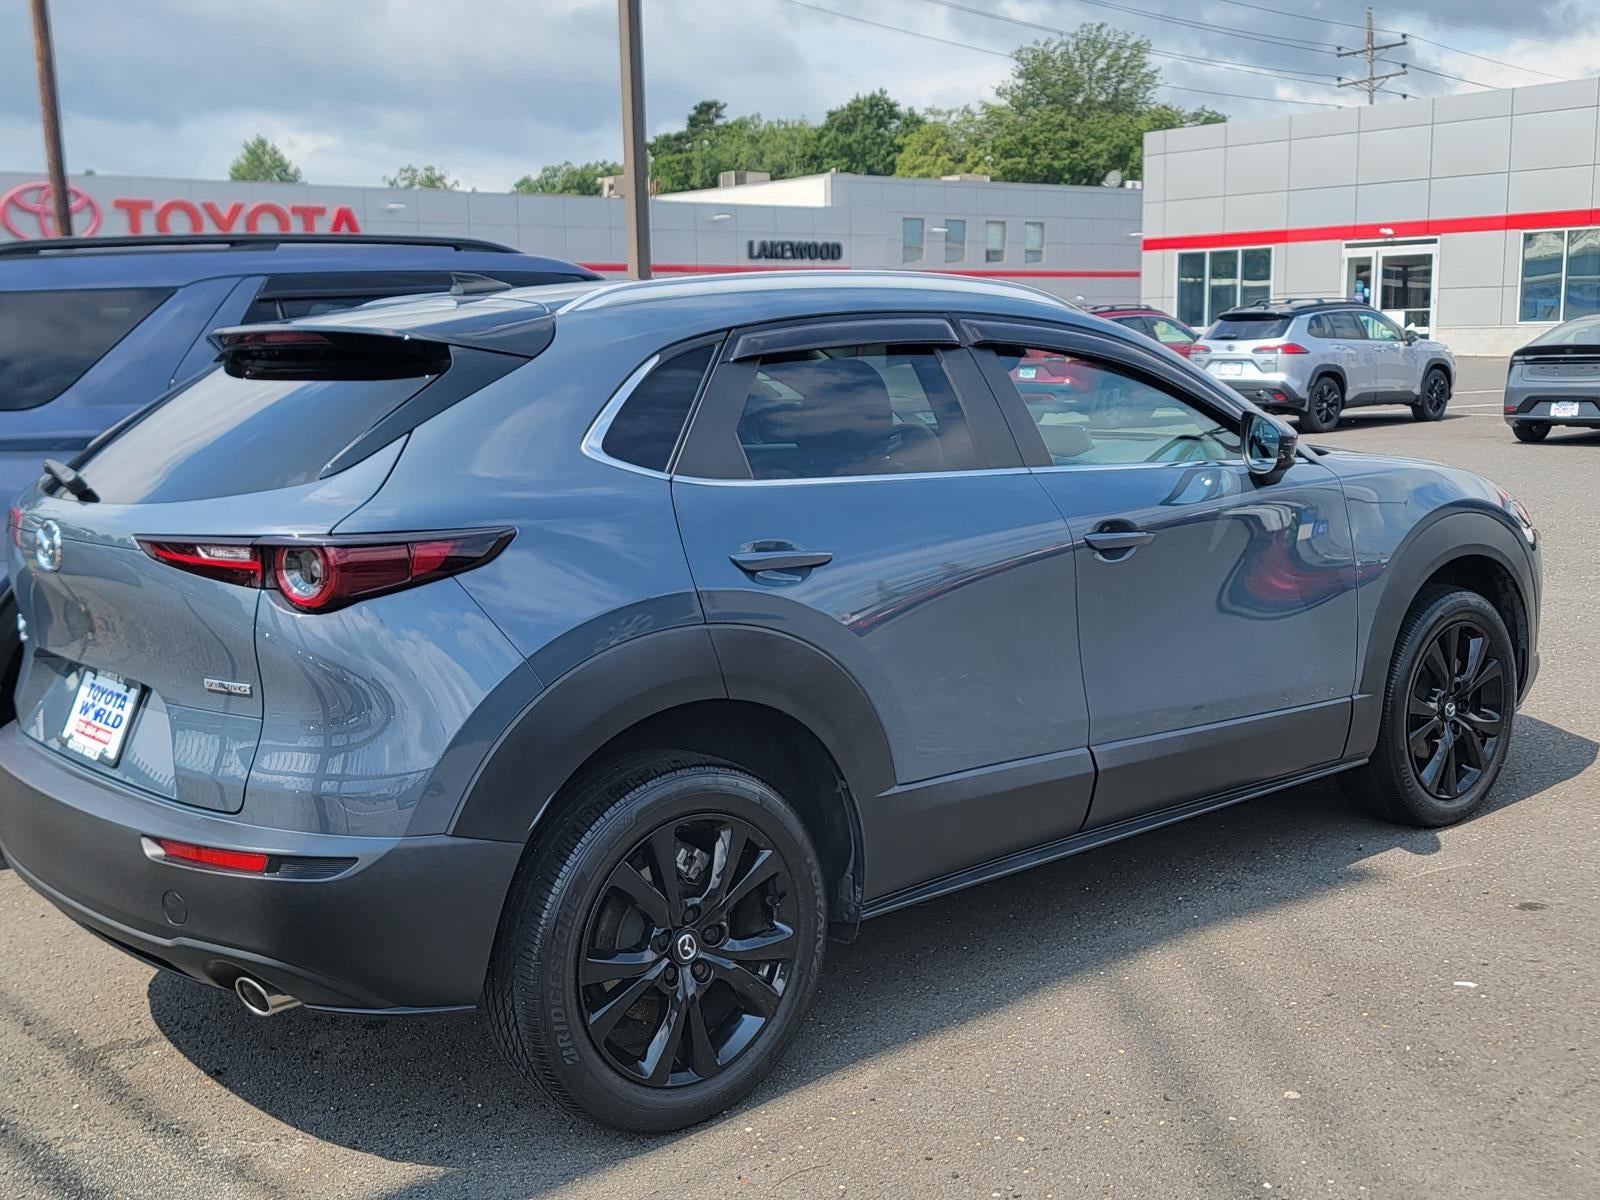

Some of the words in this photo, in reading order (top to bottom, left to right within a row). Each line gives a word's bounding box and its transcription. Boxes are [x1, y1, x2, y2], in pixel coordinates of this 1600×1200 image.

[113, 199, 361, 234] TOYOTA
[747, 239, 843, 261] LAKEWOOD
[87, 682, 128, 711] TOYOTA
